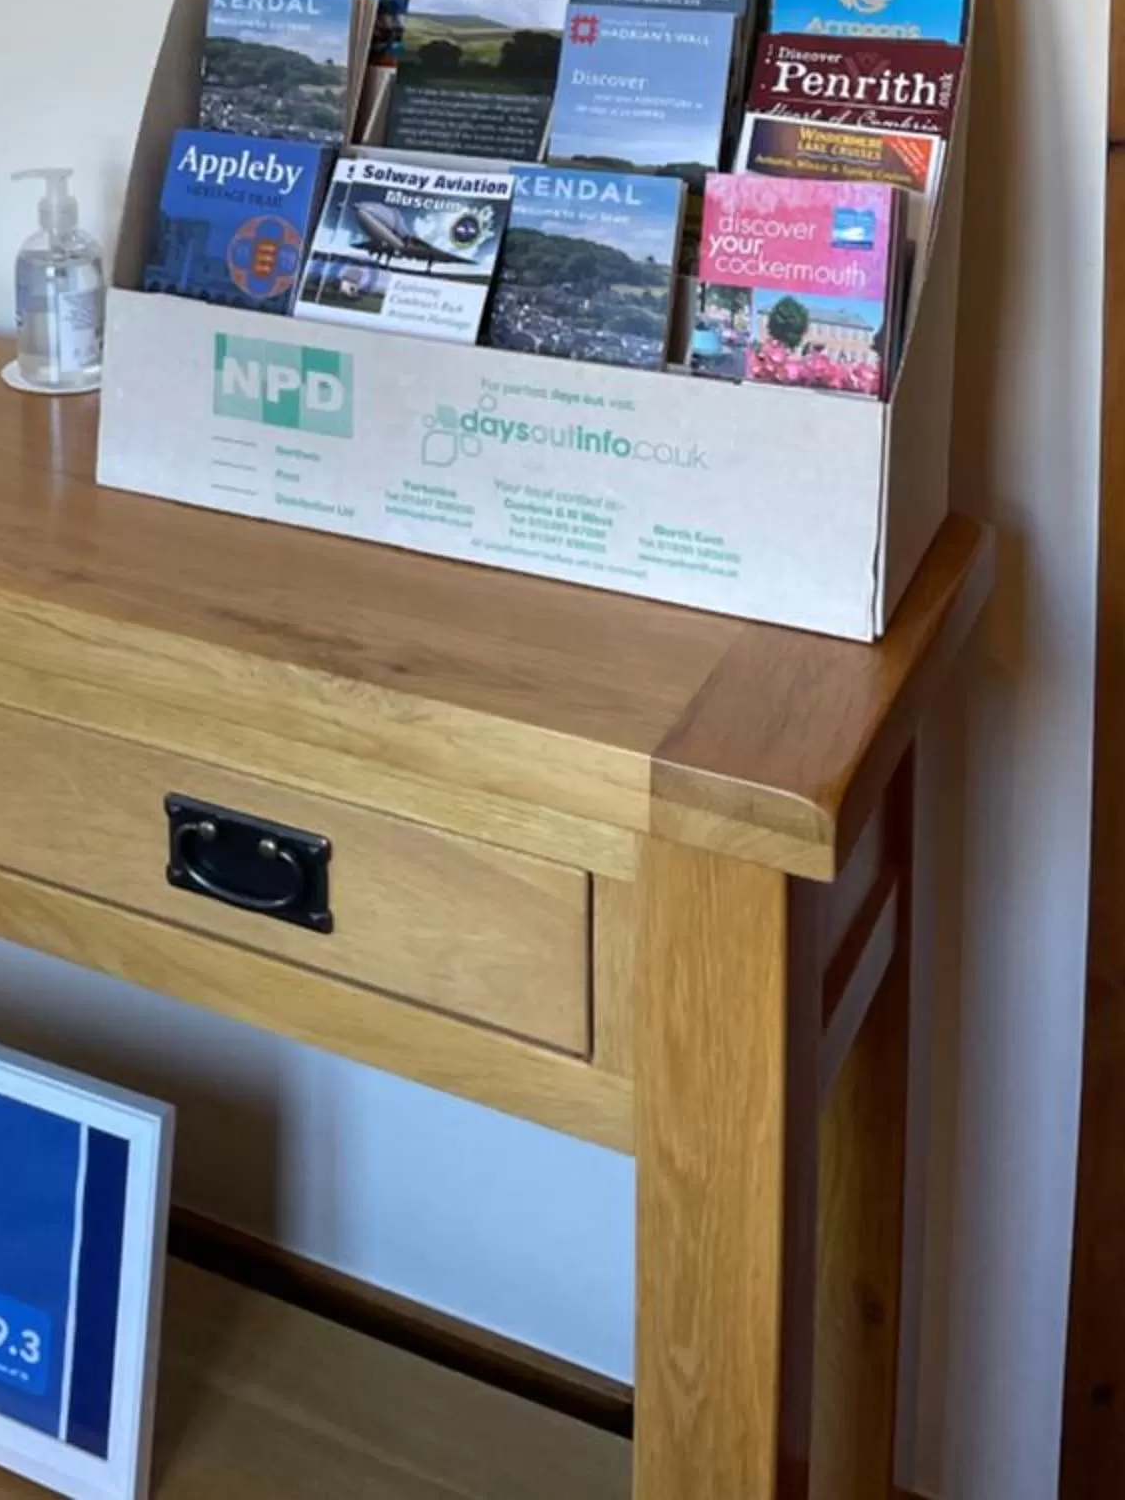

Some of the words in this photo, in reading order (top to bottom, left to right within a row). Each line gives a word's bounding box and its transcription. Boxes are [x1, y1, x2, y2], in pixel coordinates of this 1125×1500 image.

[776, 45, 843, 64] Discover
[770, 59, 939, 107] Penrith
[176, 144, 304, 195] Appleby
[362, 163, 430, 191] Solway
[433, 173, 509, 195] Aviation
[514, 175, 643, 206] KENDAL
[718, 211, 816, 241] discover
[708, 233, 764, 258] your
[715, 252, 867, 288] cockermouth
[222, 356, 345, 413] NPD
